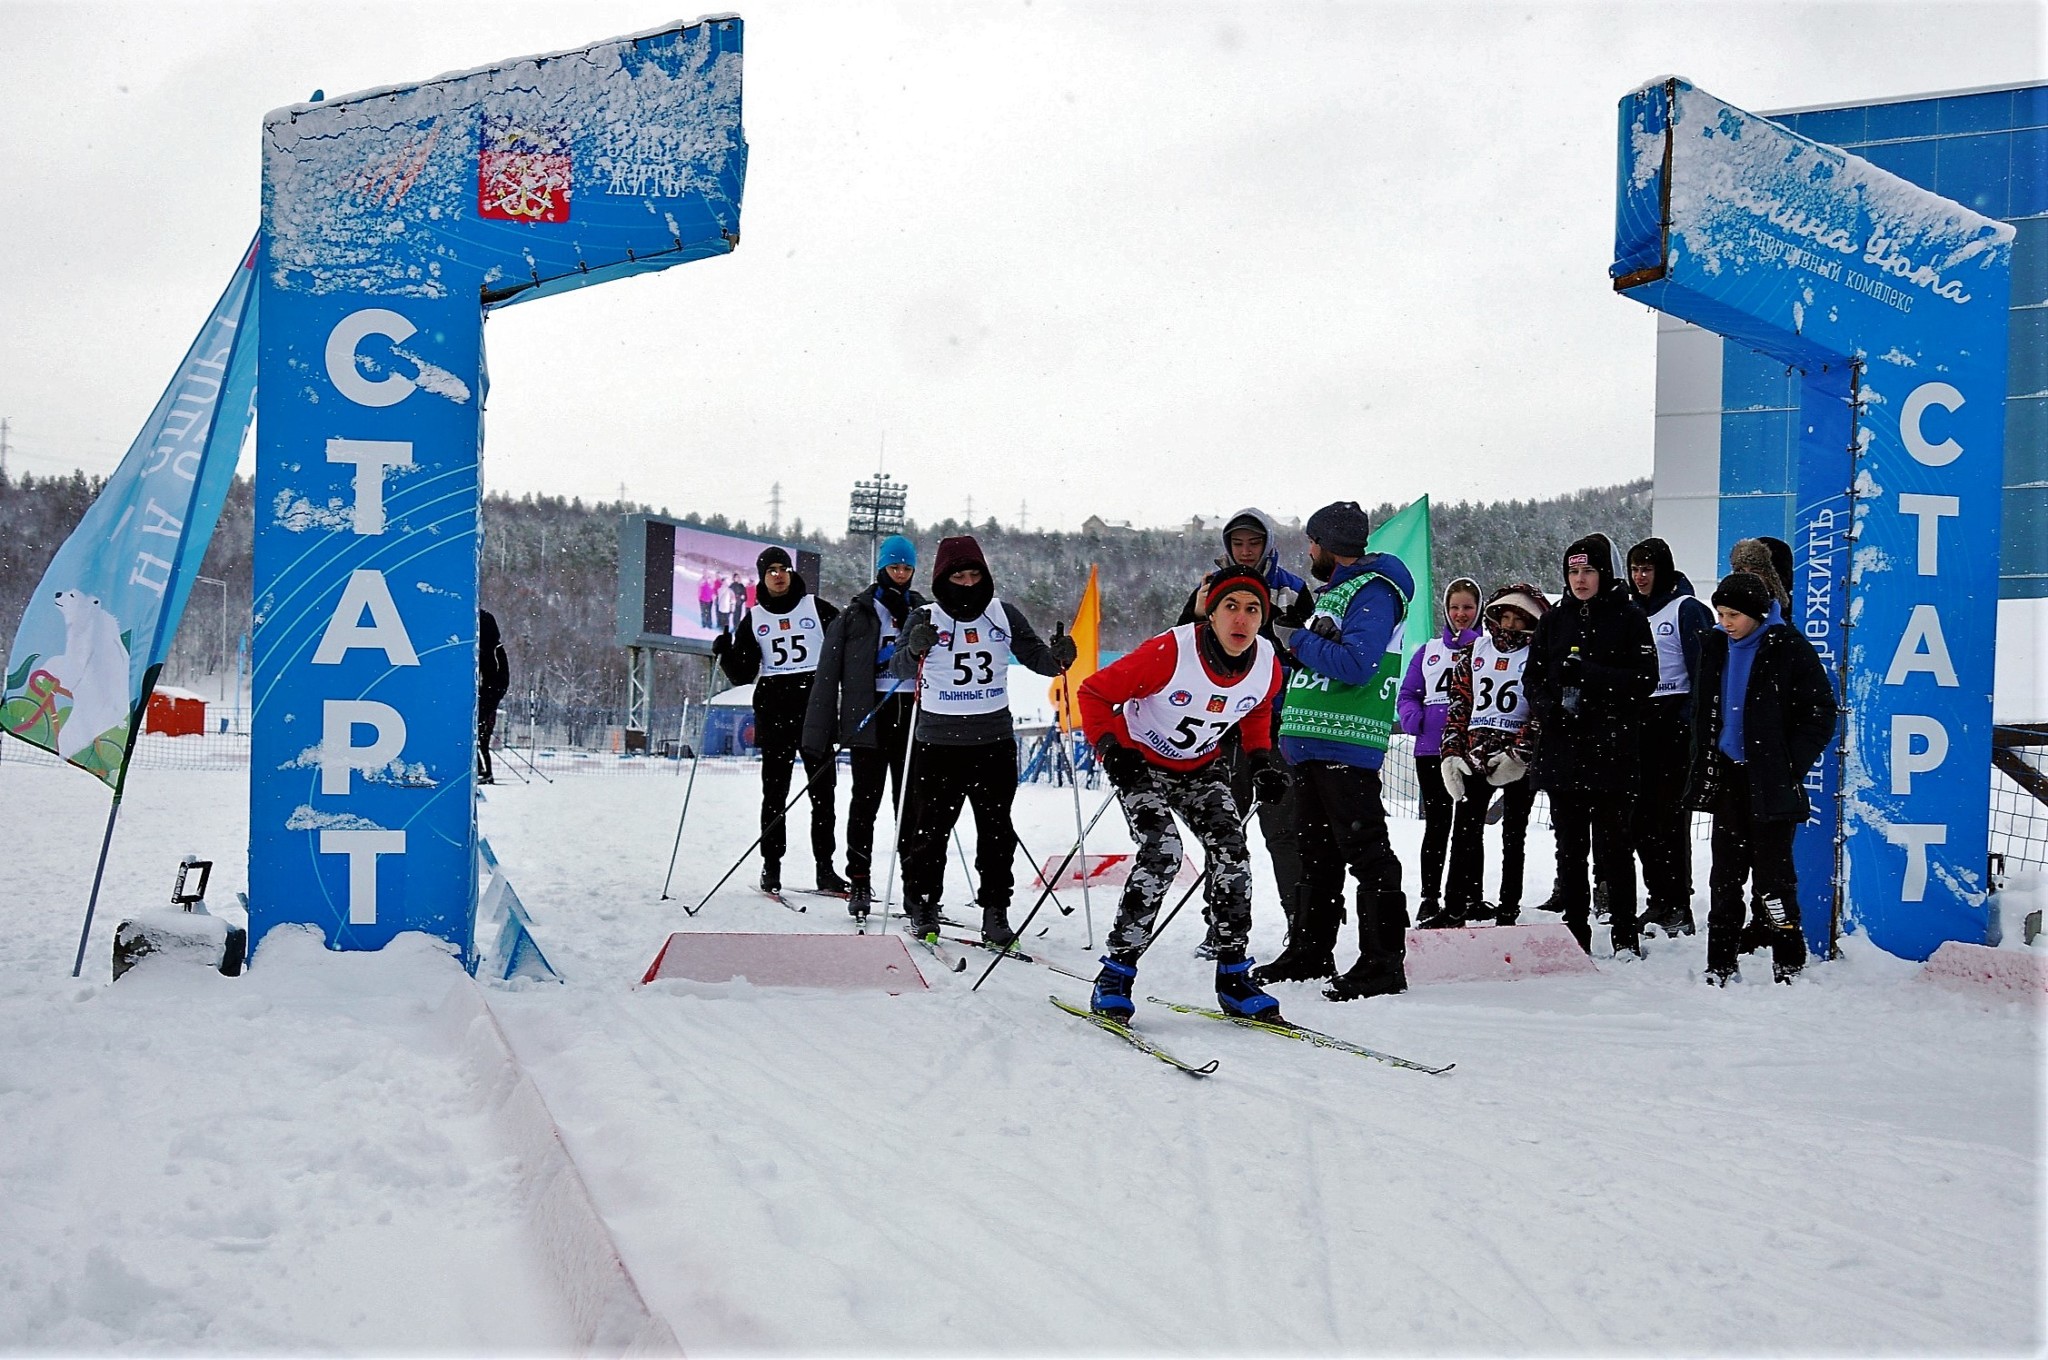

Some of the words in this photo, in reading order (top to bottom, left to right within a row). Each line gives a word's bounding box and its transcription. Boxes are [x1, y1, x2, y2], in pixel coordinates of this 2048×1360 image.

[310, 308, 421, 925] СТАРТ
[772, 634, 808, 667] 55
[1883, 382, 1966, 902] СТАРТ
[953, 651, 994, 686] 53
[939, 690, 983, 701] ЛЫЖНЫЕ
[1476, 677, 1519, 713] 36
